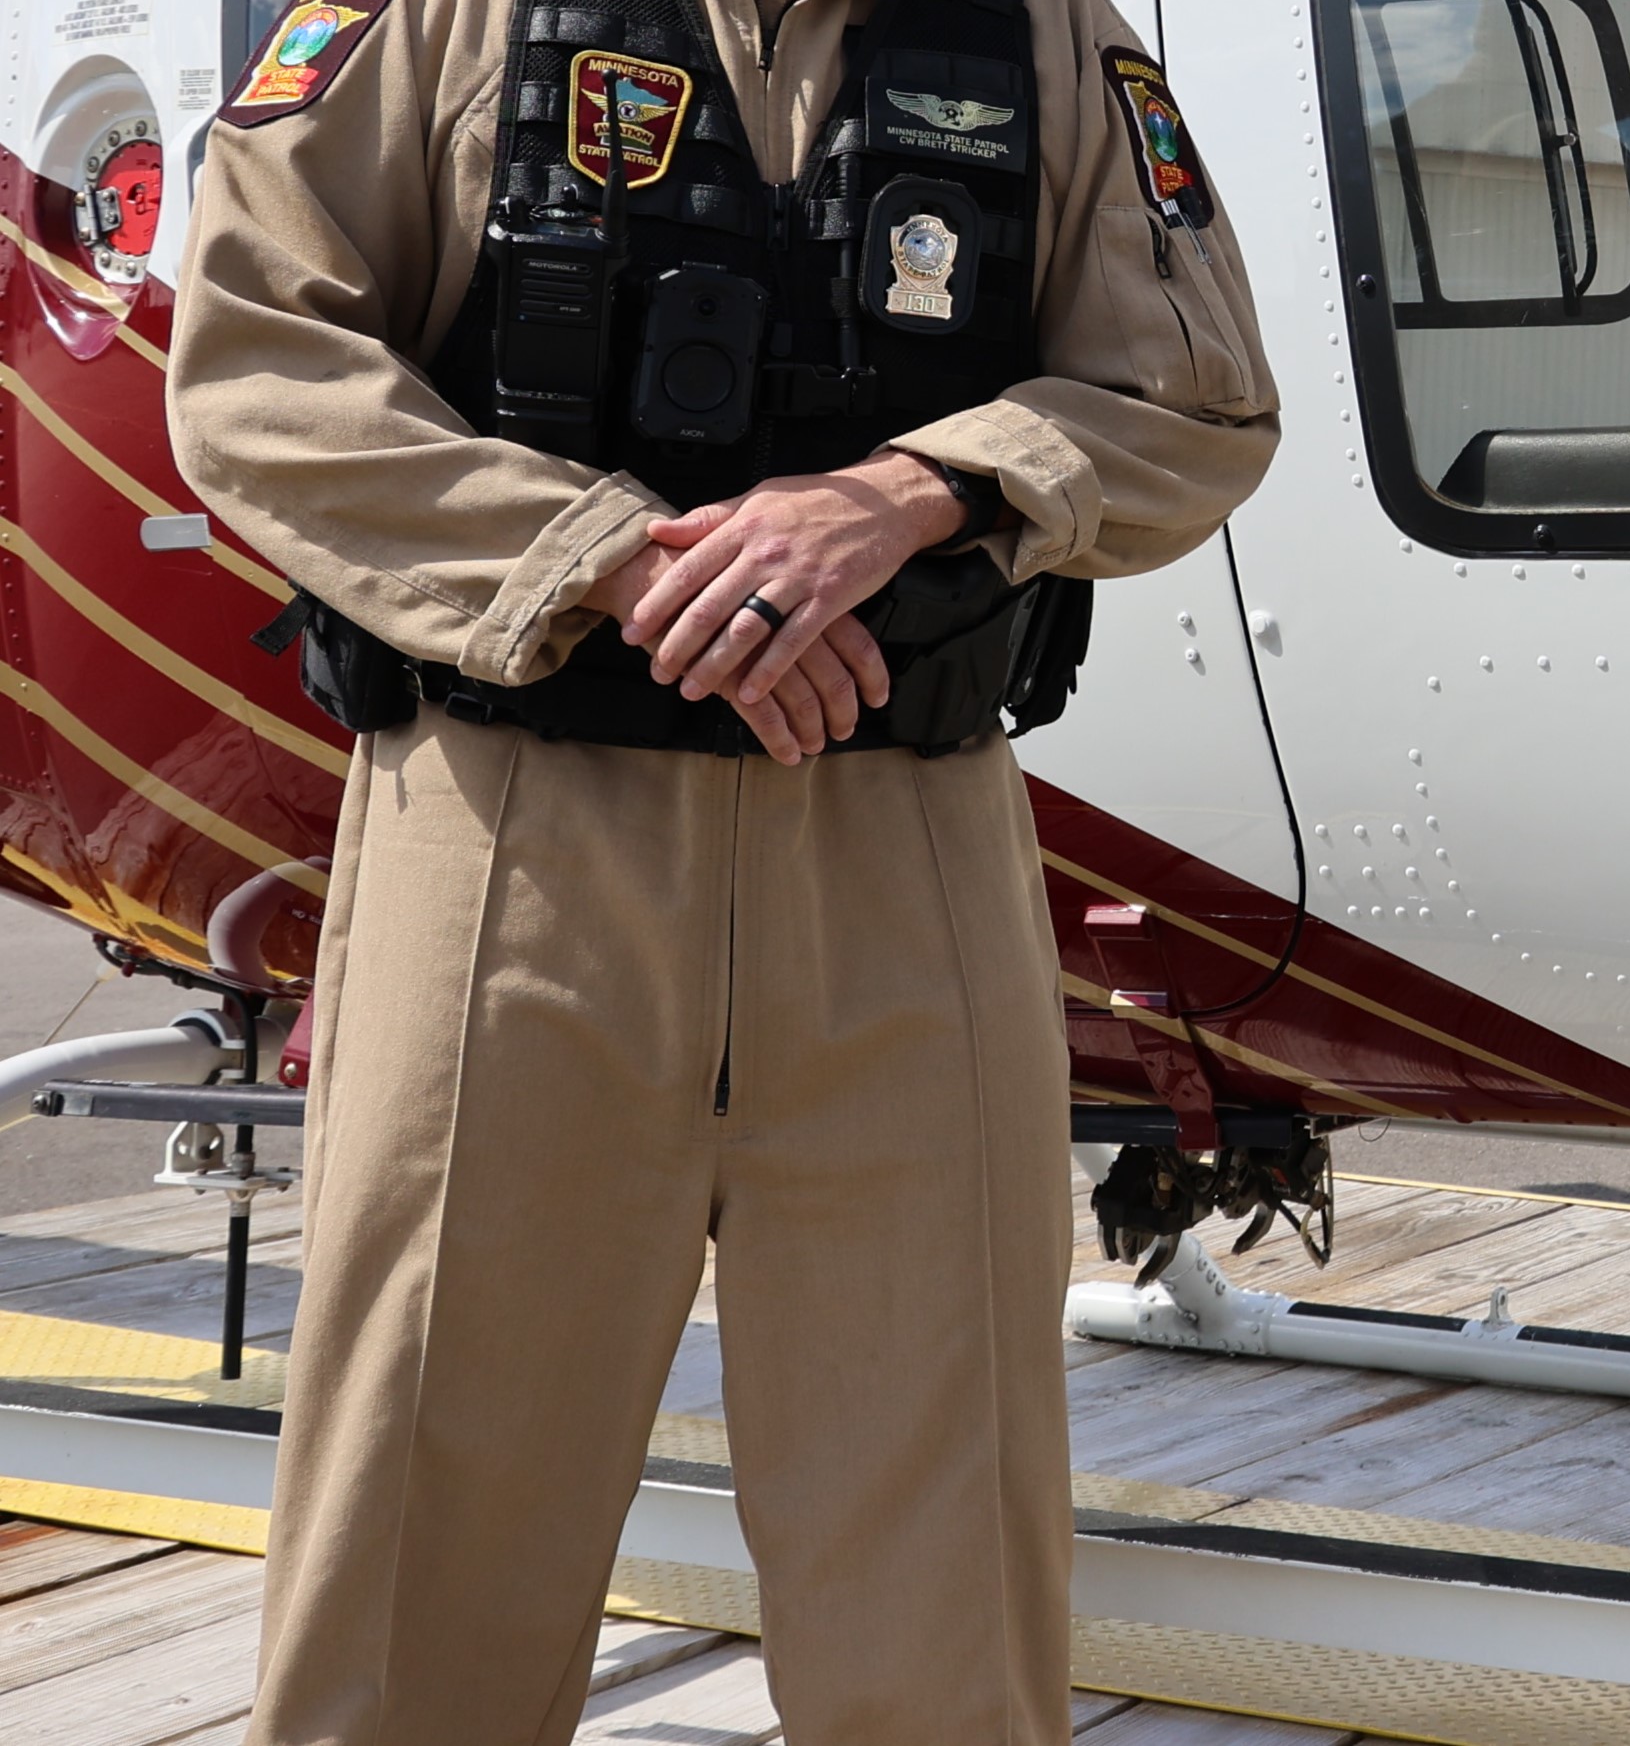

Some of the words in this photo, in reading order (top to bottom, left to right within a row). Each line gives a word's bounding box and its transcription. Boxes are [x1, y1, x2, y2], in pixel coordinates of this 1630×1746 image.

[269, 68, 306, 81] STATE
[588, 59, 679, 88] MINNESOTA
[257, 82, 301, 96] PATROL
[887, 126, 941, 140] MINNESOTA
[944, 134, 971, 146] STATE
[974, 139, 1009, 153] PATROL
[899, 136, 915, 145] CW
[918, 139, 947, 150] BRETT
[950, 144, 996, 159] STRICKER
[622, 151, 661, 167] ATROL
[1160, 166, 1184, 179] STATE
[528, 262, 577, 271] MOTOROLA
[906, 294, 935, 313] 130
[680, 429, 705, 438] AXON
